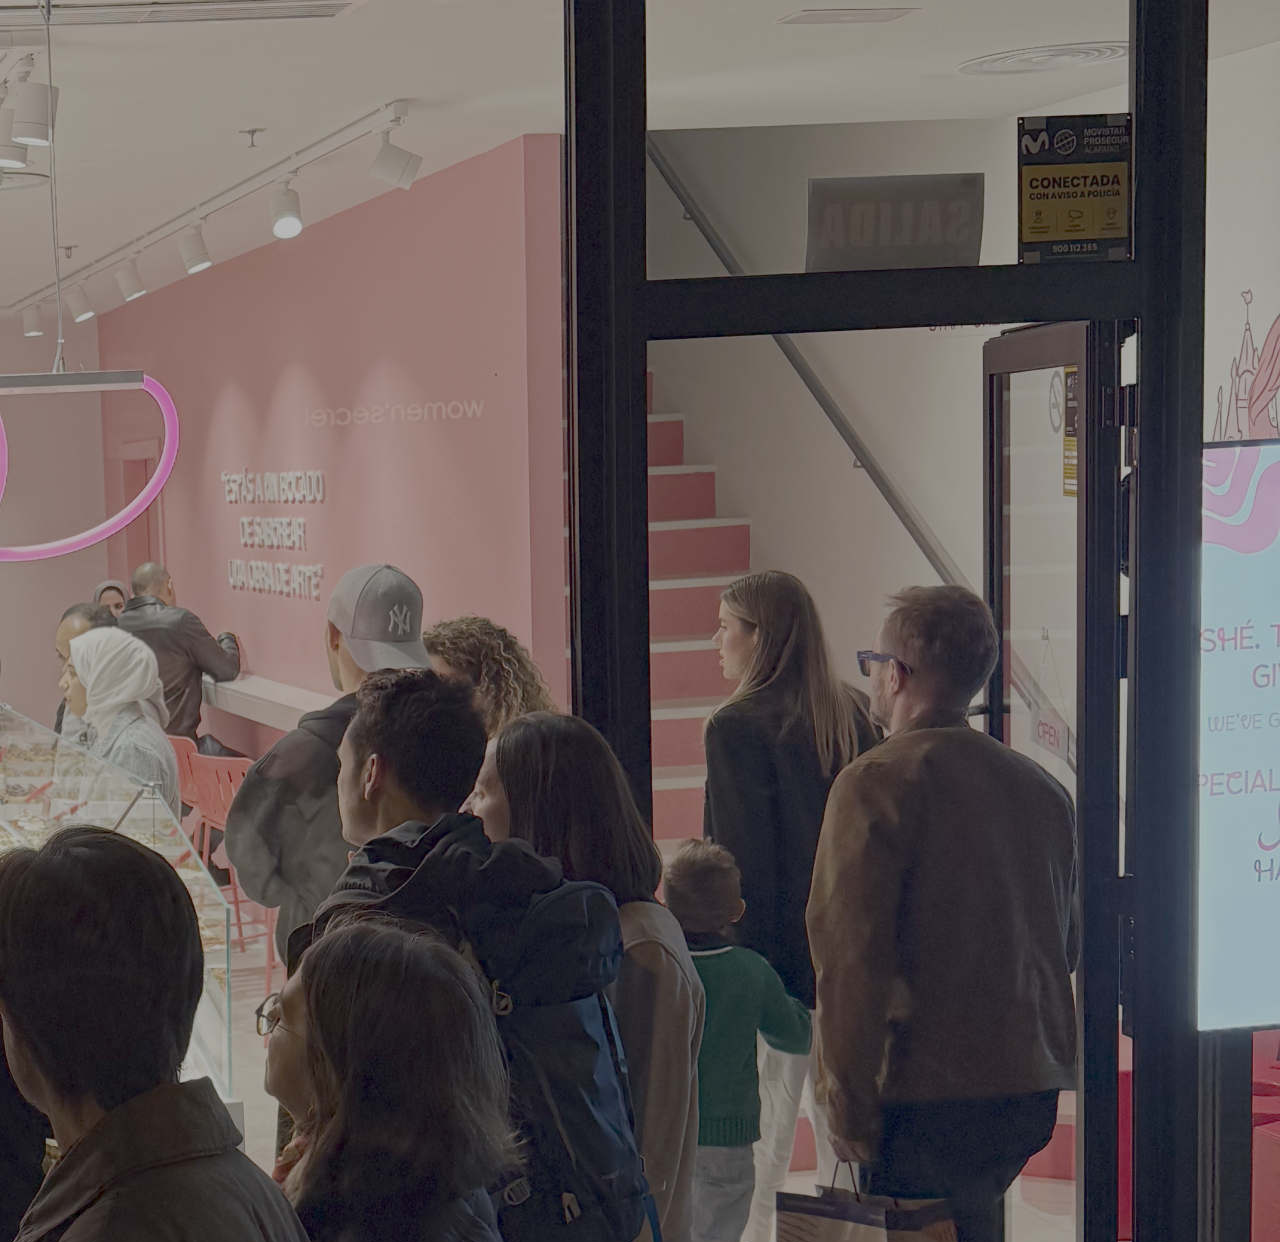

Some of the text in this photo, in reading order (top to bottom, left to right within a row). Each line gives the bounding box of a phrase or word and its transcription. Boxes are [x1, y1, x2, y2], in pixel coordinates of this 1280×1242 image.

[1083, 127, 1126, 136] MOVISTAR
[1083, 135, 1130, 145] PROSEGUR
[1029, 174, 1121, 190] CONECTADA
[1029, 187, 1121, 201] CON AVISO A POLICÍA
[1052, 244, 1067, 253] 900
[1069, 244, 1081, 252] 112
[280, 471, 325, 503] BOCADO
[239, 517, 306, 550] DE SABOREAR
[248, 560, 274, 594] OBRA
[275, 562, 290, 597] DE
[1252, 663, 1280, 688] GI
[1208, 713, 1263, 732] WE'VE
[1037, 719, 1060, 749] OPEN
